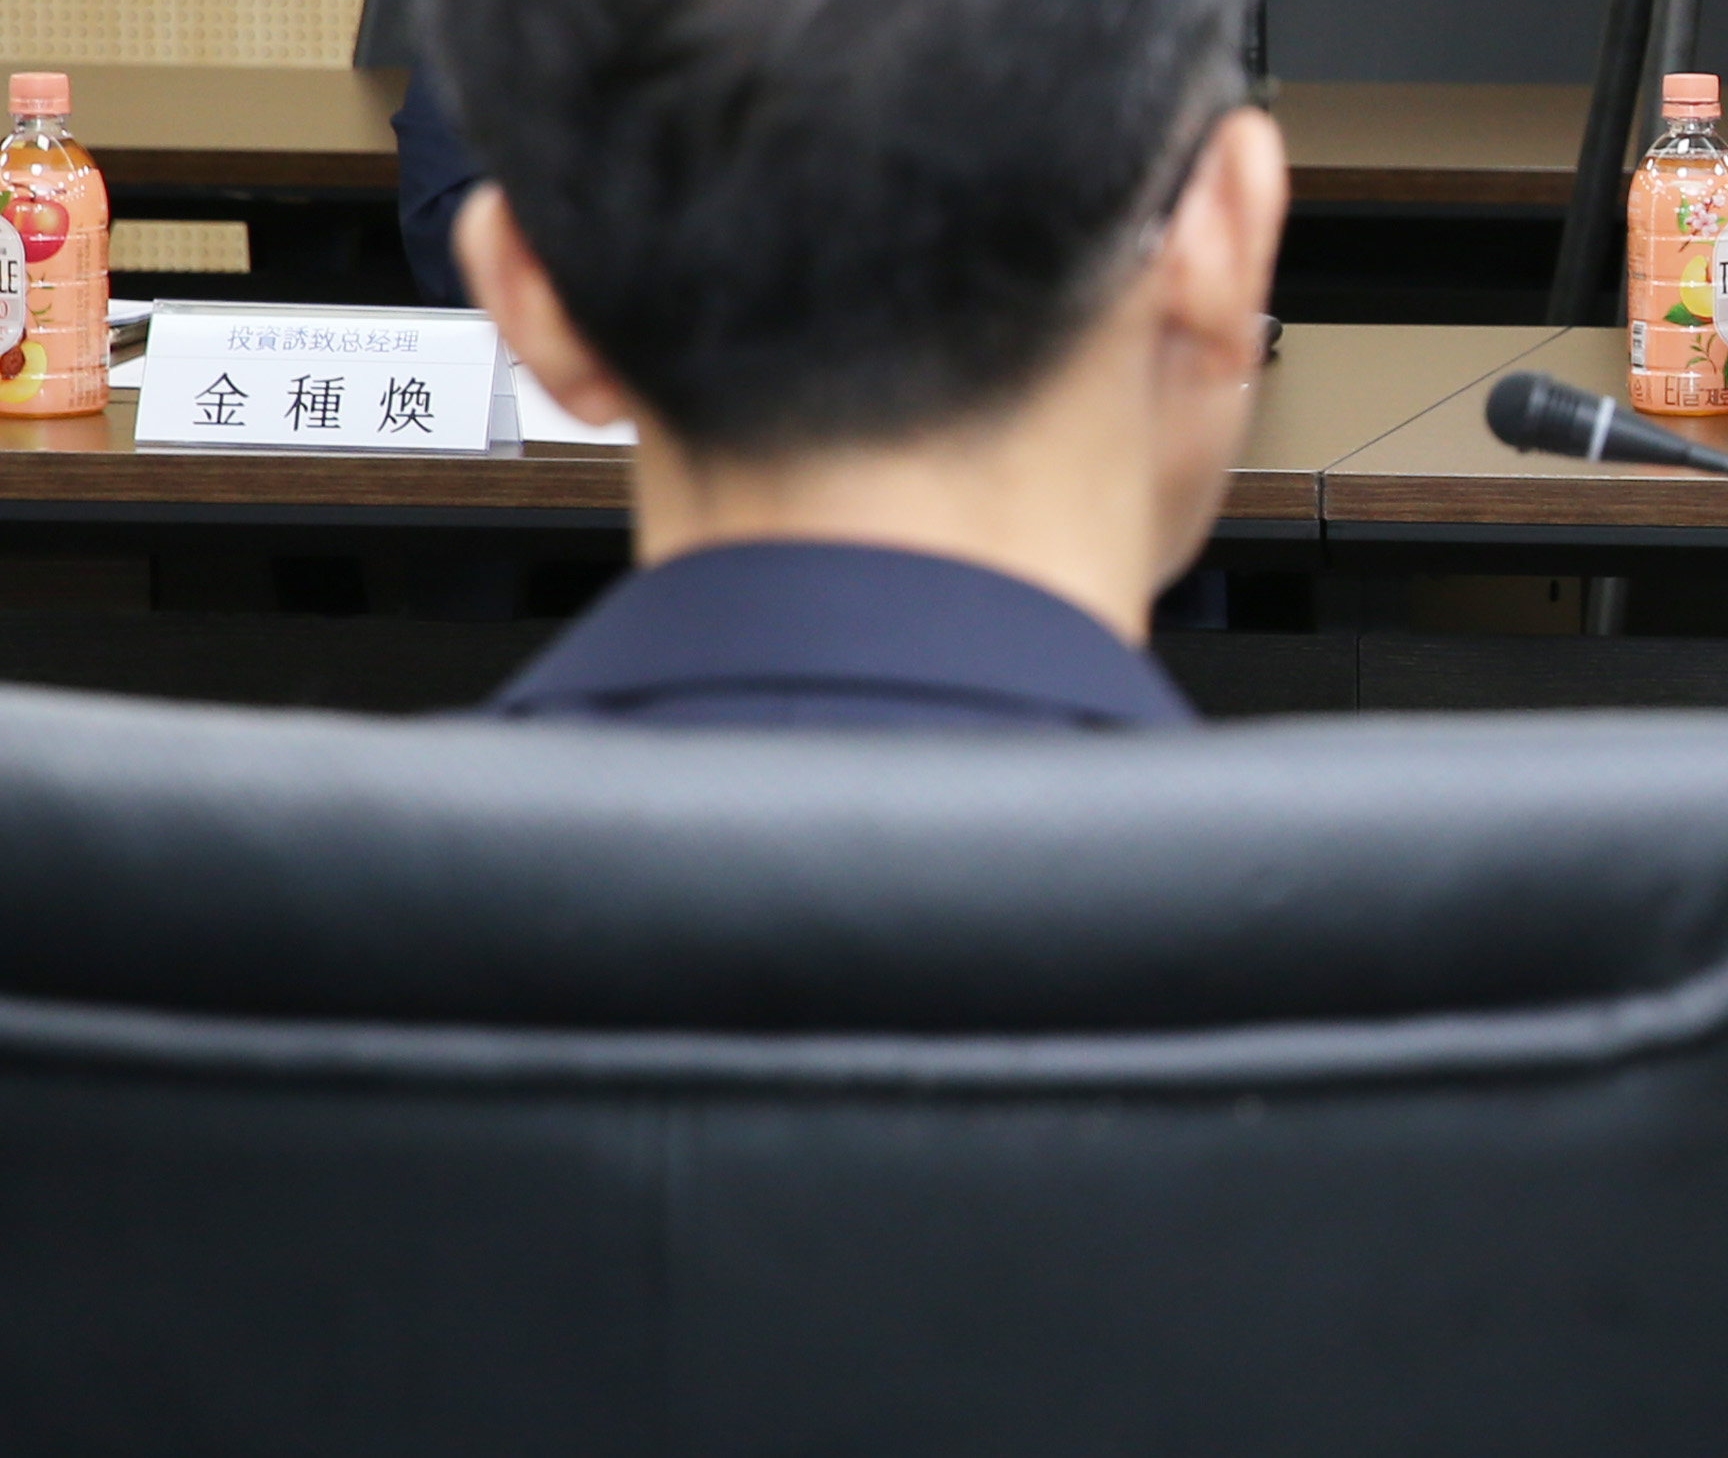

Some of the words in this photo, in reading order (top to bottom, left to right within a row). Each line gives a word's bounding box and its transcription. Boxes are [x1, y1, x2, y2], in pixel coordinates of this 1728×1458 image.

[227, 325, 420, 353] 投資誘致总经理
[193, 372, 434, 434] 金種煥
